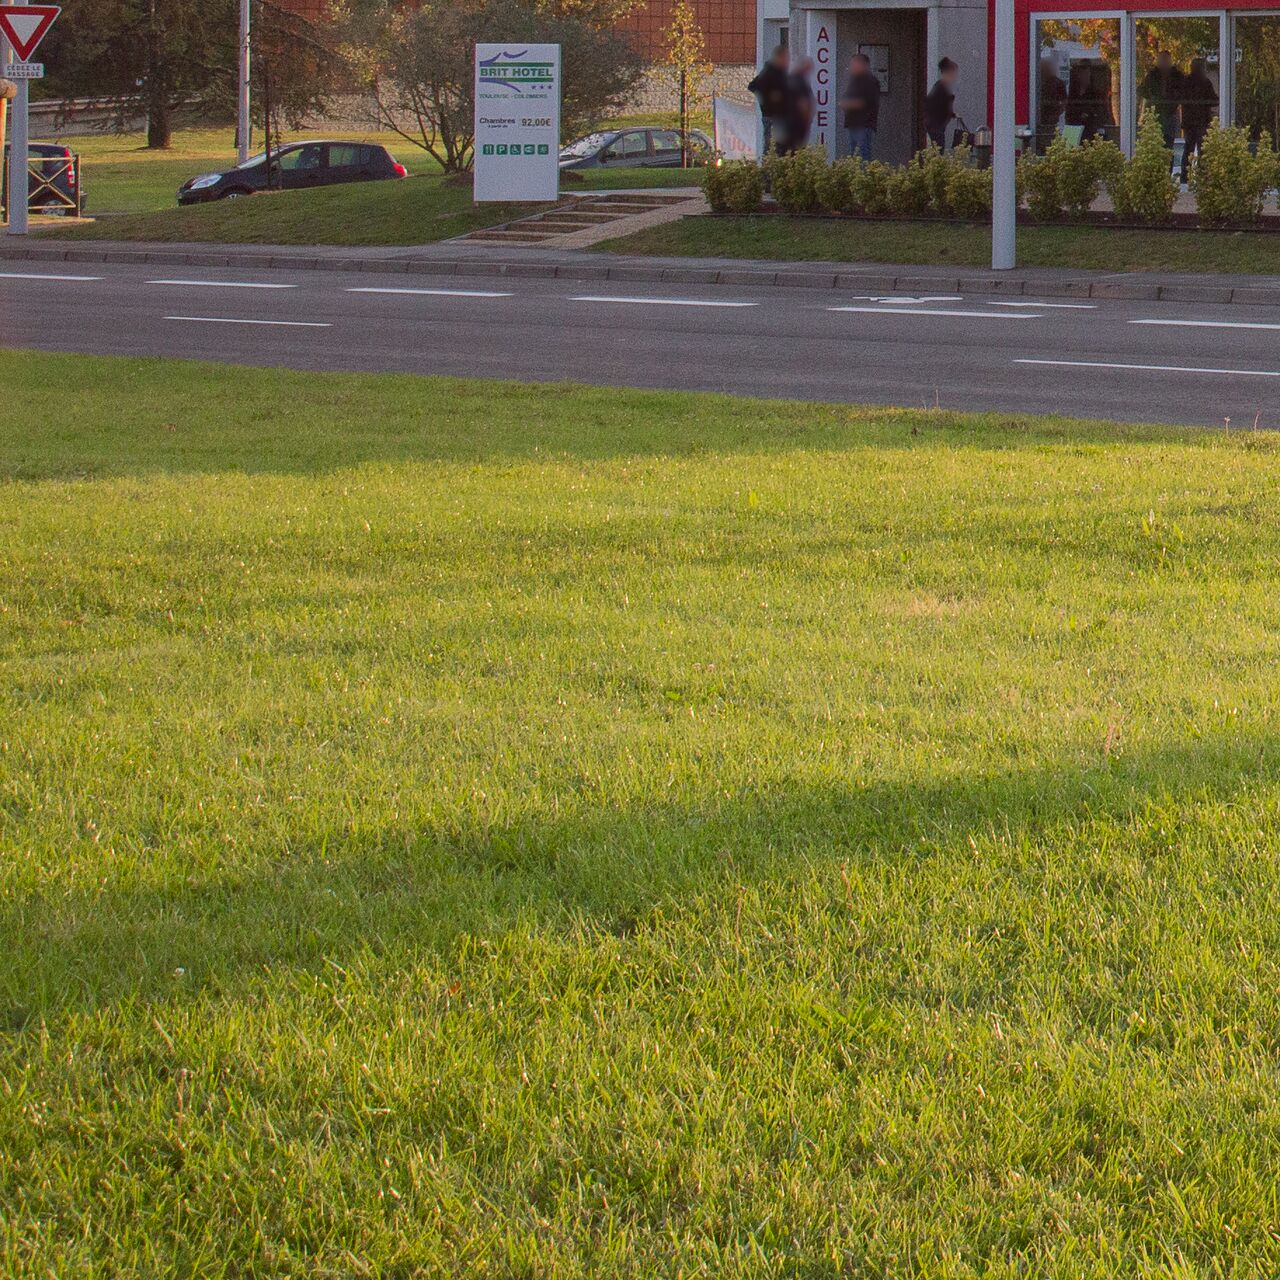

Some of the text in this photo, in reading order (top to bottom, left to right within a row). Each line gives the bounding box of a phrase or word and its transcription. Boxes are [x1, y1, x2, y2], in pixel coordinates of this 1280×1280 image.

[480, 68, 553, 77] BRIT HOTEL
[816, 26, 830, 145] ACCUEI
